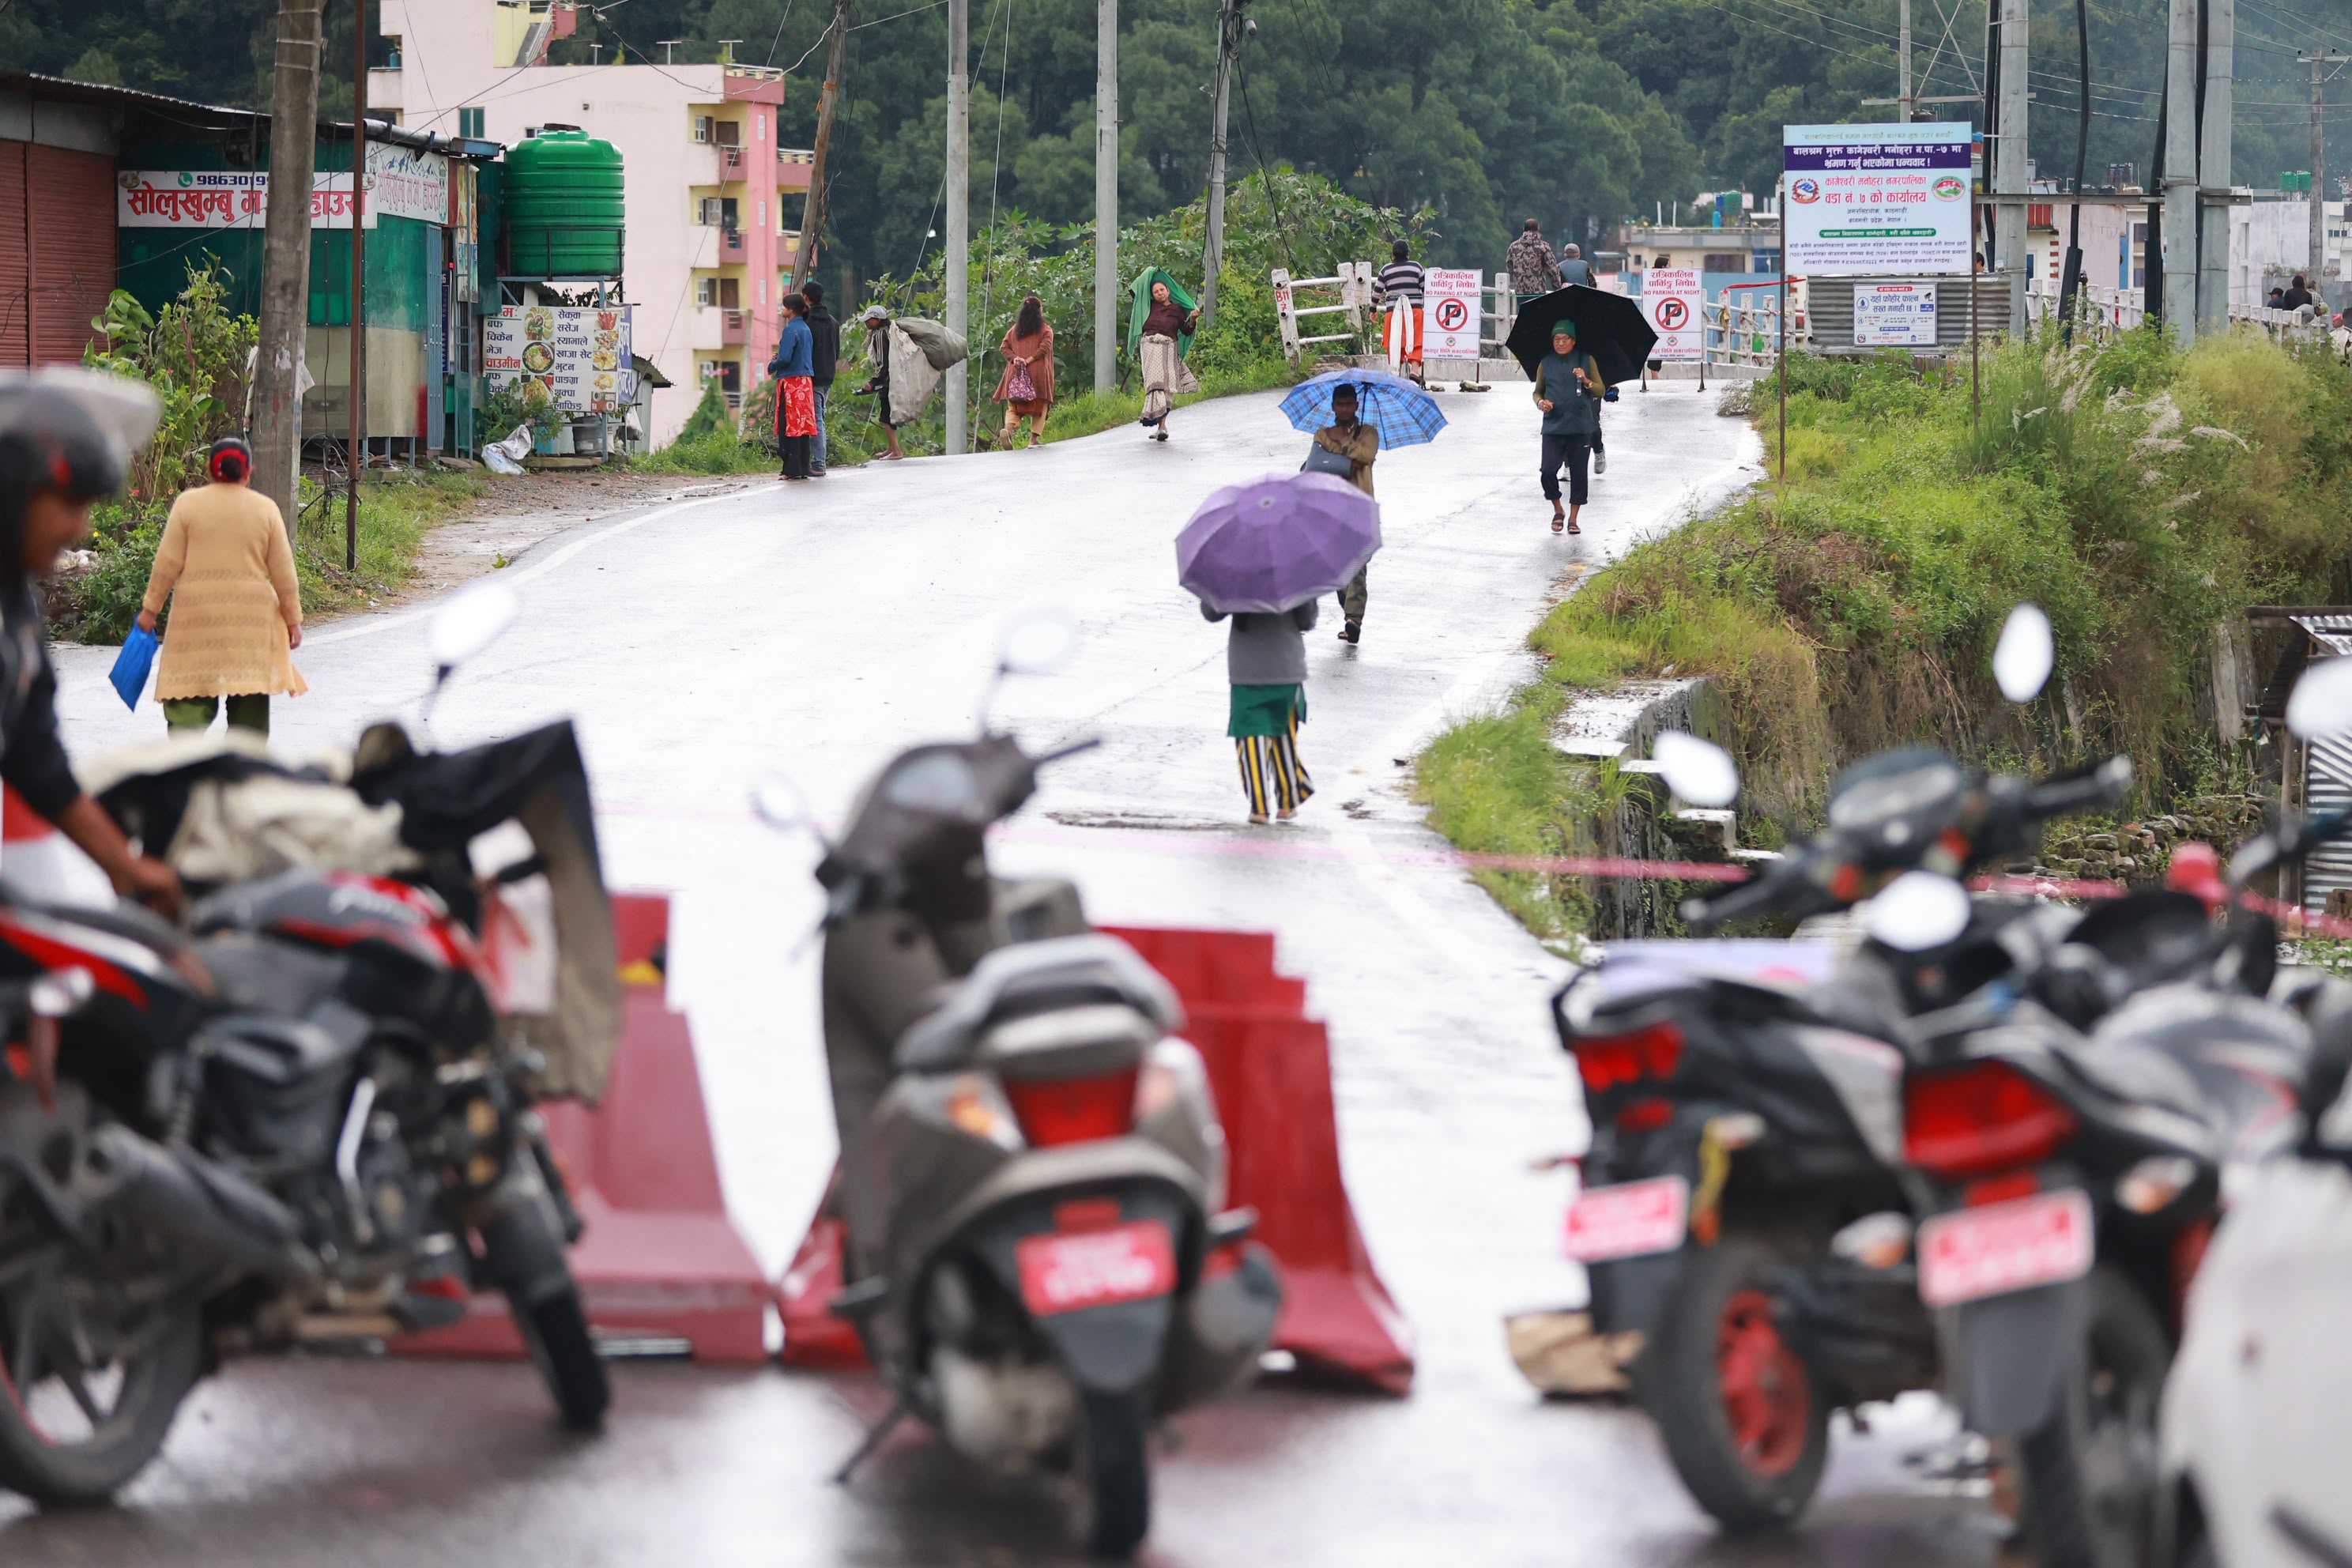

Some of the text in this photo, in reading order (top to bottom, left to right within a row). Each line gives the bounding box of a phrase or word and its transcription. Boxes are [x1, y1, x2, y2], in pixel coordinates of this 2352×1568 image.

[1793, 147, 1822, 156] बालश्रम
[1826, 146, 1842, 158] मुक्त
[1846, 144, 1881, 155] कागेश्वरी
[1885, 144, 1912, 155] मनोहरा
[1951, 145, 1962, 153] मा
[1824, 159, 1846, 168] भ्रमण
[1848, 156, 1862, 170] गर्नु
[1863, 156, 1894, 168] भएकोमा
[1825, 174, 1927, 187] कागेश्वरी मनोहरा नगरपालिका
[127, 180, 236, 222] सोलुखुम्बु
[1825, 192, 1841, 204] वडा
[1860, 193, 1866, 203] ७
[1871, 189, 1883, 203] को
[1886, 189, 1927, 203] कार्यालय
[1433, 271, 1474, 280] रात्रिकालिन
[1651, 270, 1694, 279] रात्रिकालिन
[1457, 280, 1476, 288] निषेध
[1675, 278, 1696, 287] निषेध
[1883, 293, 1900, 303] फोहोर
[1888, 303, 1905, 313] मनाही
[558, 309, 581, 321] सेकुवा
[557, 322, 579, 333] ससेज
[487, 331, 514, 341] चिकेन
[556, 336, 588, 346] स्याभाले
[486, 345, 503, 354] भेज
[556, 349, 593, 359] खाजा सेट
[485, 356, 522, 369] चाउमीन
[555, 363, 575, 372] भुटन
[553, 400, 583, 411] लाफिङ
